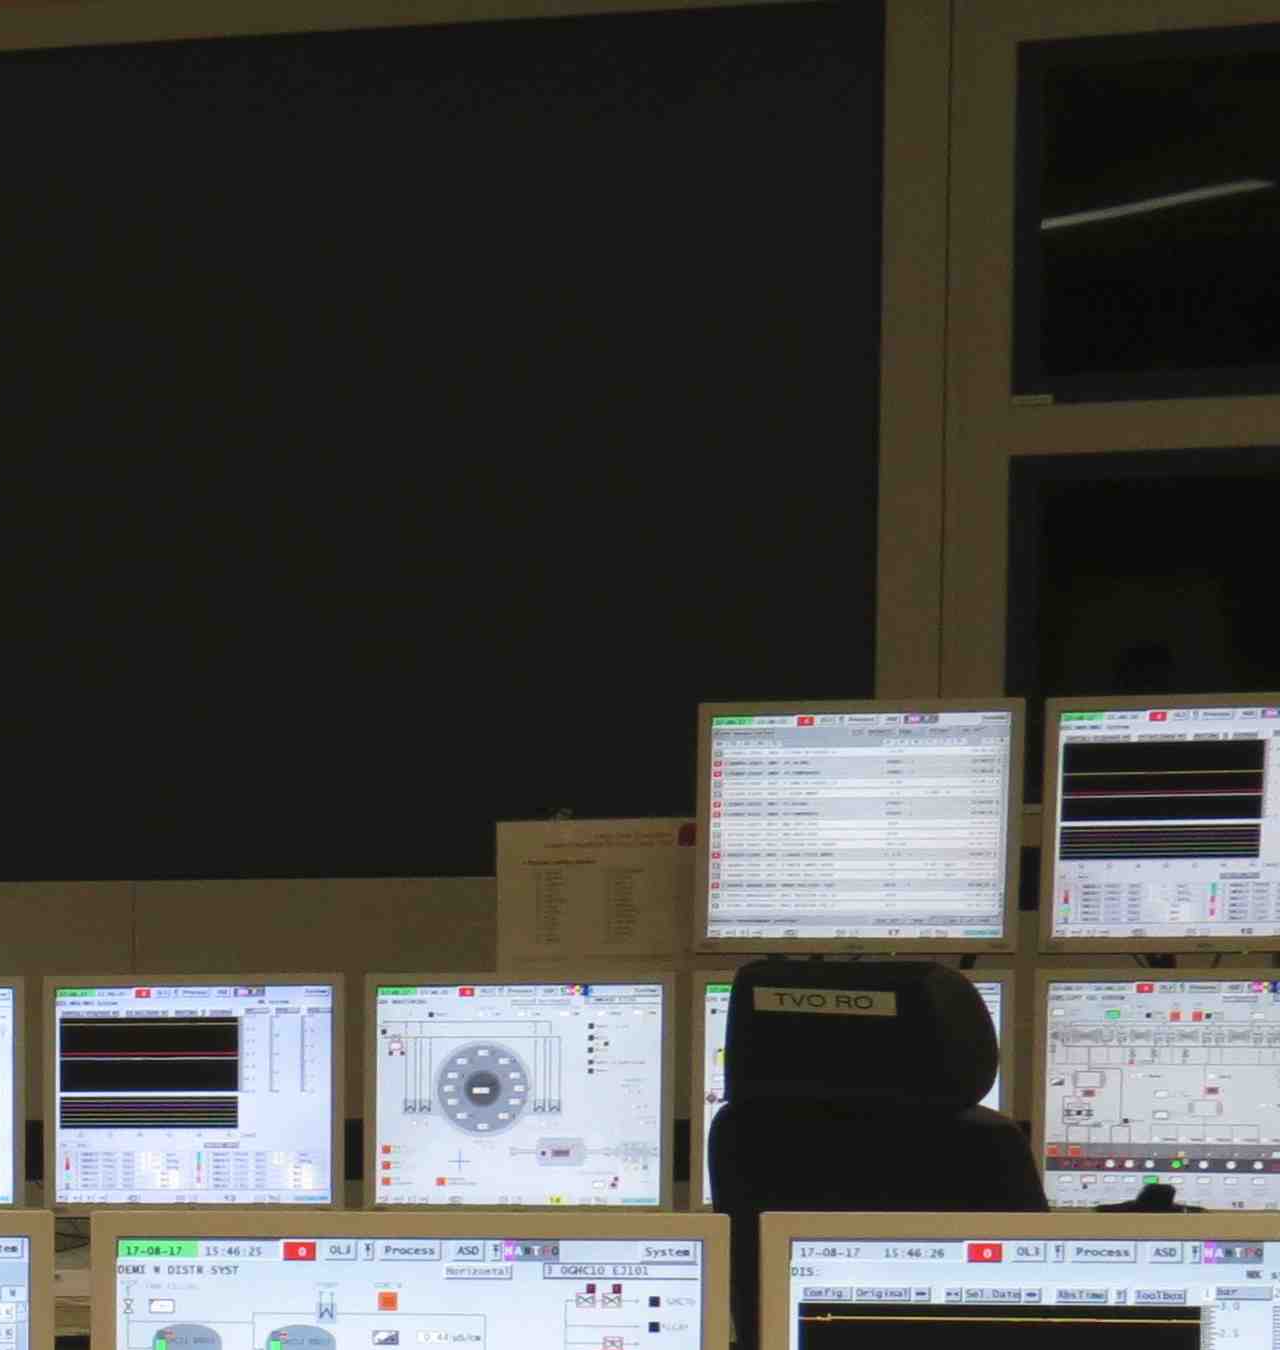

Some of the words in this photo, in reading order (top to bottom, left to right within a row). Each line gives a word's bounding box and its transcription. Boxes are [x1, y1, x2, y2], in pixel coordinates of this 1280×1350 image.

[773, 991, 827, 1008] TVO
[835, 995, 873, 1009] RO
[384, 1246, 435, 1256] Process
[645, 1247, 690, 1259] System
[1075, 1247, 1130, 1258] Process
